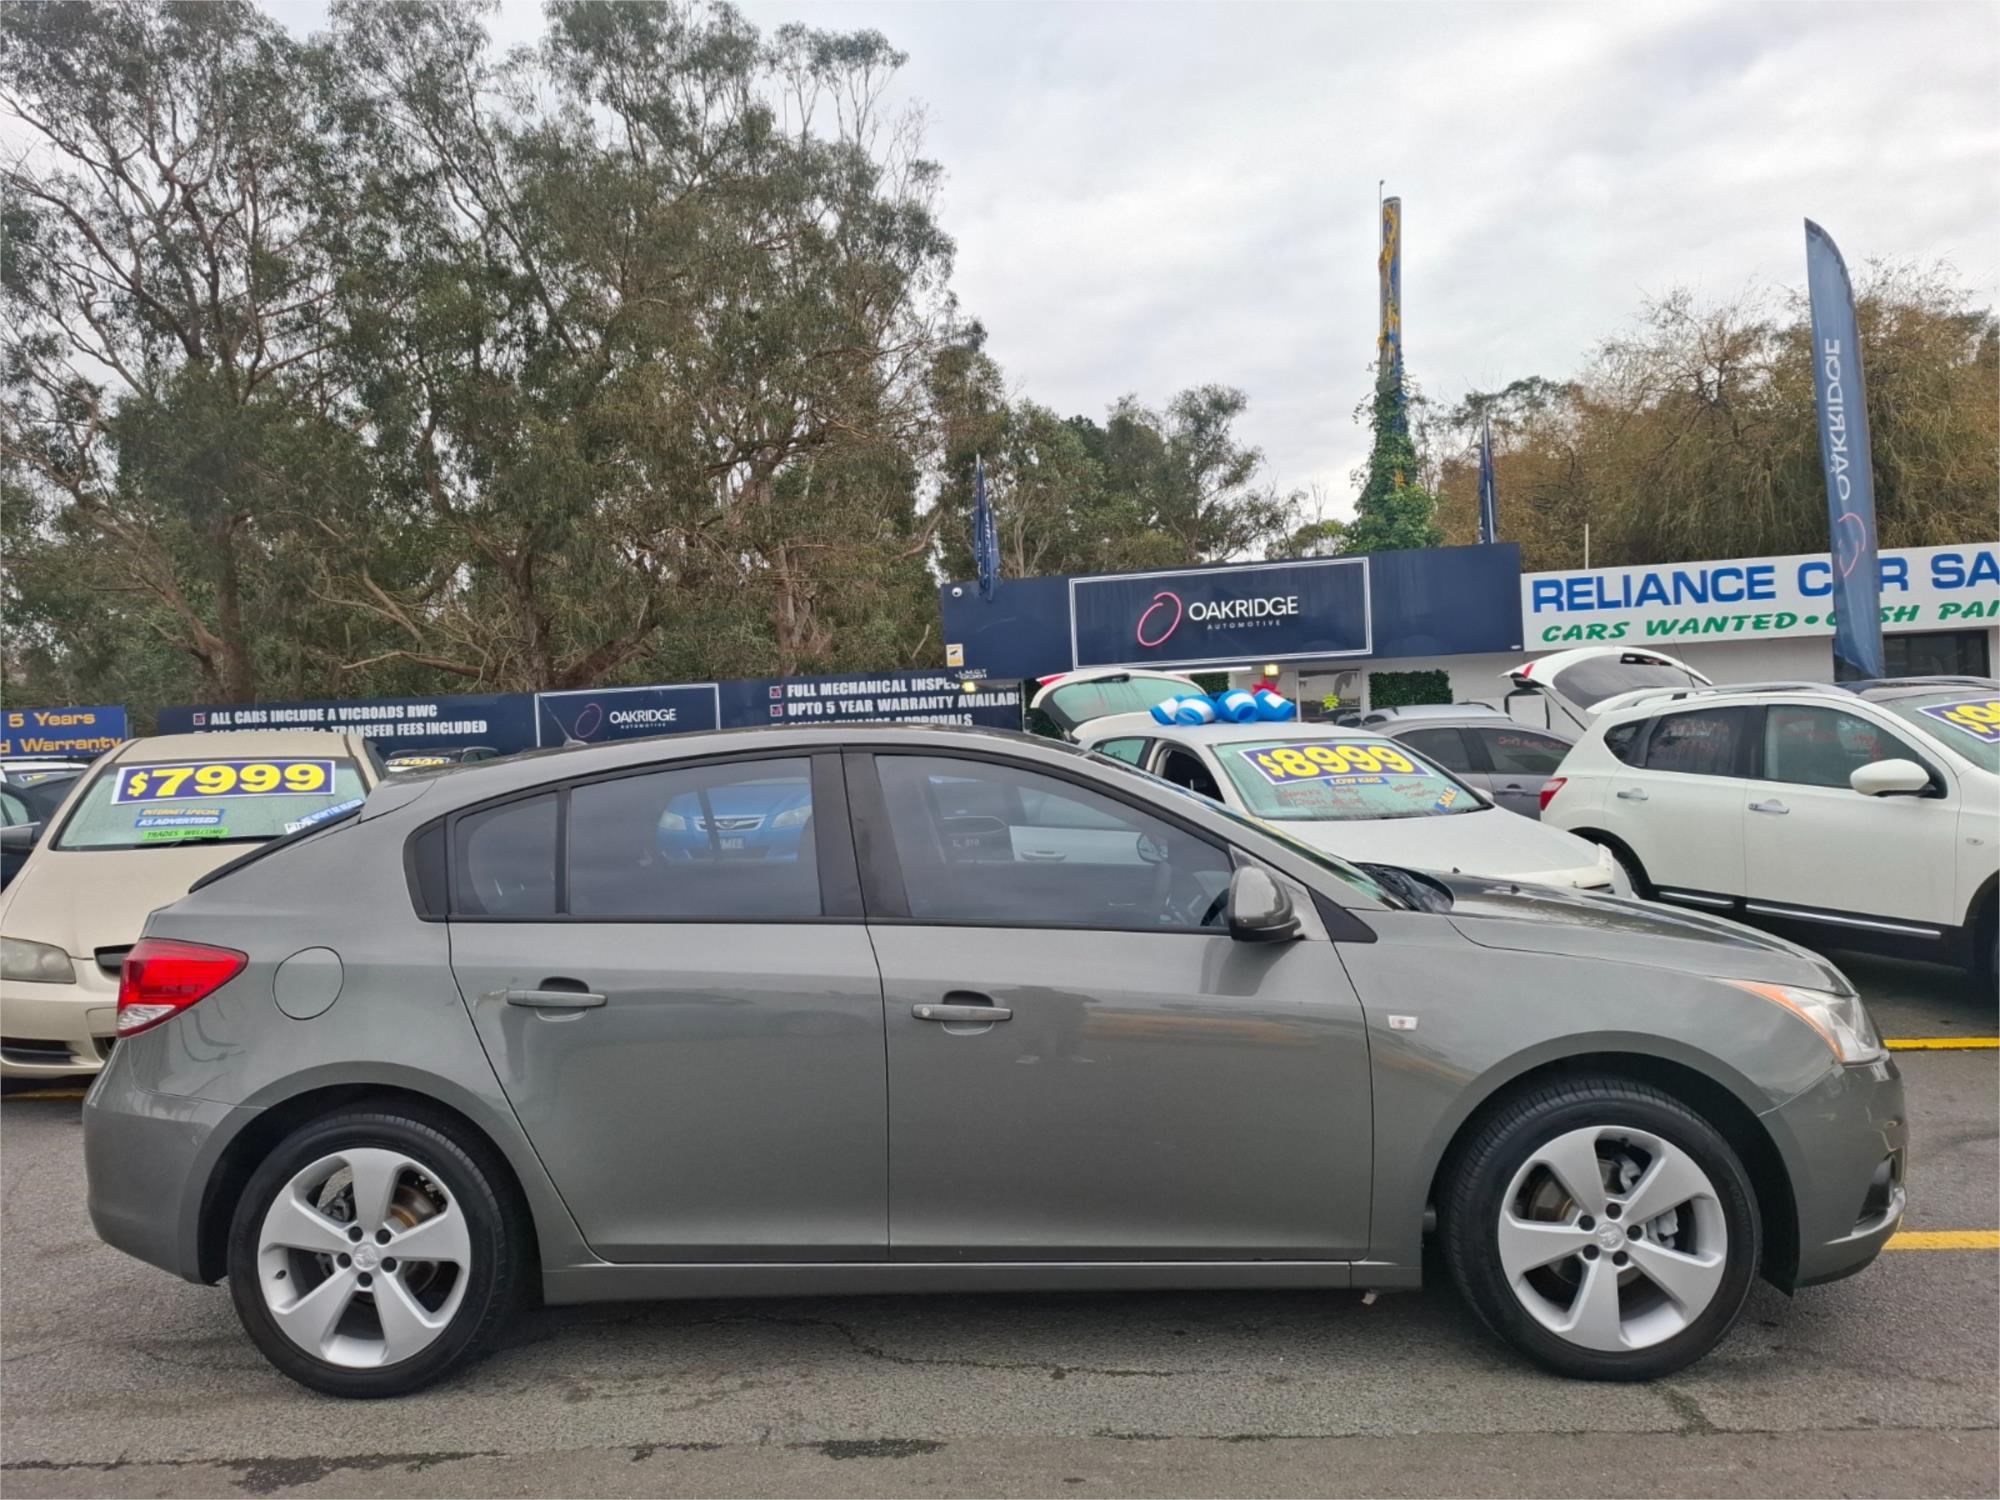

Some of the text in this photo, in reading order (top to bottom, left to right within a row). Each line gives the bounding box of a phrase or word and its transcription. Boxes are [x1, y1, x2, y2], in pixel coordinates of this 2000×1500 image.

[1533, 565, 1776, 613] RELIANCE
[1798, 556, 1908, 596] CR
[1188, 596, 1298, 620] OAKRIDGE
[1207, 620, 1281, 630] AUTOMOTIVE
[1542, 622, 1630, 642] CARS
[1646, 612, 1798, 636] WANTED
[1826, 604, 1920, 626] CSH
[787, 684, 816, 698] FULL
[820, 680, 908, 696] MECHANICAL
[210, 704, 438, 725] ALL CARS INCLUDE A VICROADS RWC
[610, 708, 676, 724] OAKRIDGE
[788, 702, 822, 716] UPTO
[826, 701, 836, 714] 5
[840, 700, 873, 713] YEAR
[878, 696, 954, 712] WARRANTY
[8, 712, 96, 728] 5 Years
[397, 722, 424, 736] FEES
[426, 720, 488, 735] INCLUDED
[1942, 702, 2000, 735] $9
[20, 737, 122, 752] Warranty
[1257, 745, 1414, 778] $8999
[127, 763, 325, 797] $7999
